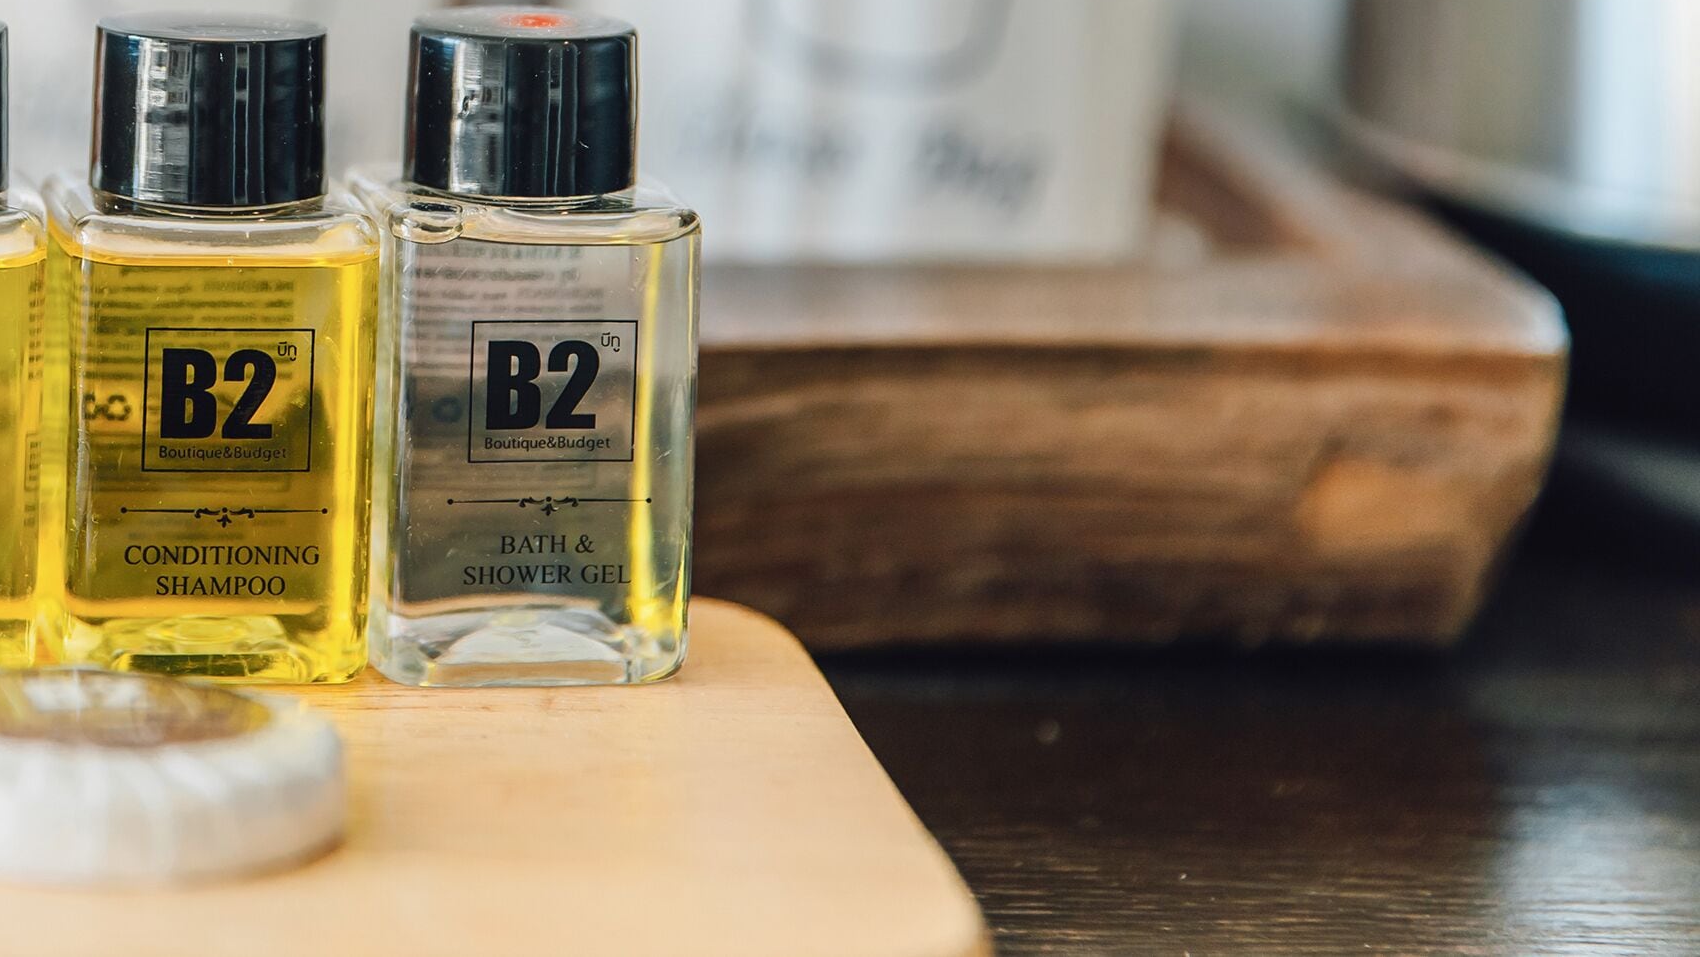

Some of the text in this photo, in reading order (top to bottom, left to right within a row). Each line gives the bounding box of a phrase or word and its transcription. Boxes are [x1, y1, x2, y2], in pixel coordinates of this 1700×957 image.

[159, 347, 277, 440] B2
[485, 339, 600, 430] B2
[158, 445, 287, 462] Boutique&Budget
[484, 436, 611, 452] Boutique&Budget
[500, 534, 595, 555] BATH &
[123, 545, 320, 566] CONDITIONING
[462, 564, 632, 586] SHOWER GEL
[155, 575, 287, 597] SHAMPOO
